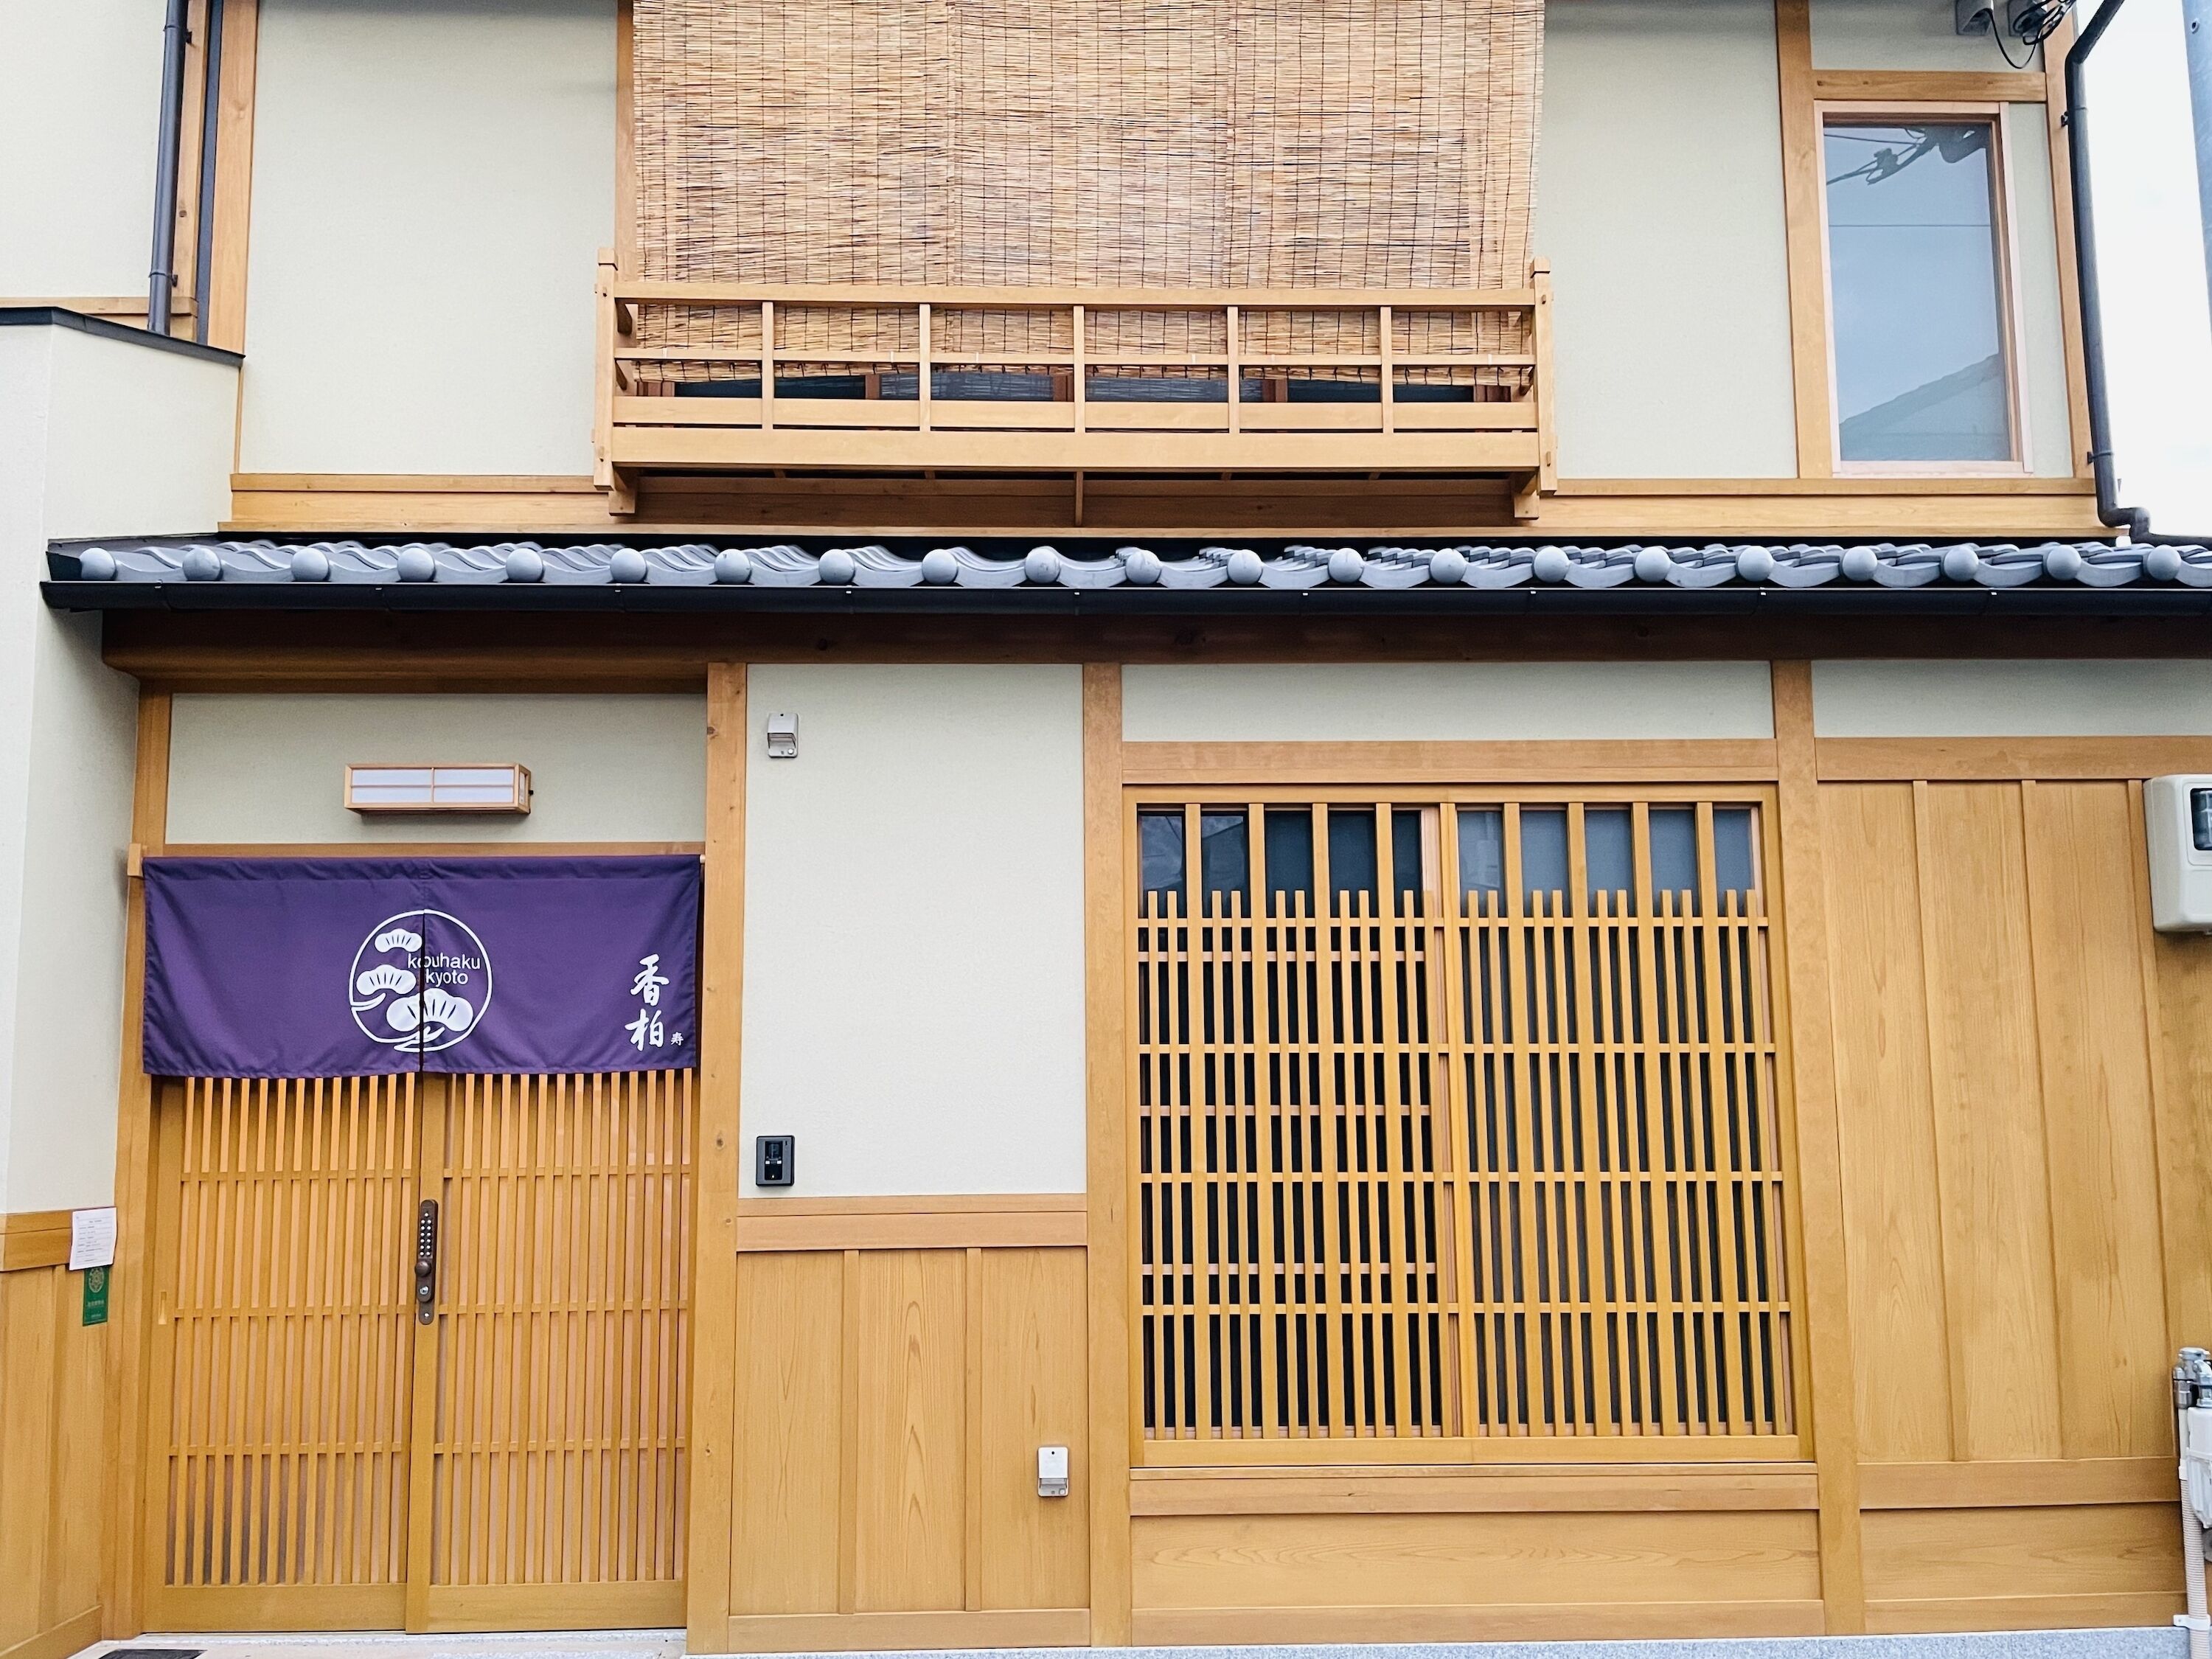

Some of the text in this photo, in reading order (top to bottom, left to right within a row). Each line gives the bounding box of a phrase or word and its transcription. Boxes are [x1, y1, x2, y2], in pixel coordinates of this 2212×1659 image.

[407, 952, 481, 970] kouhaku
[425, 968, 470, 987] kyoto
[624, 953, 671, 1052] 香柏
[670, 1031, 685, 1046] 寿
